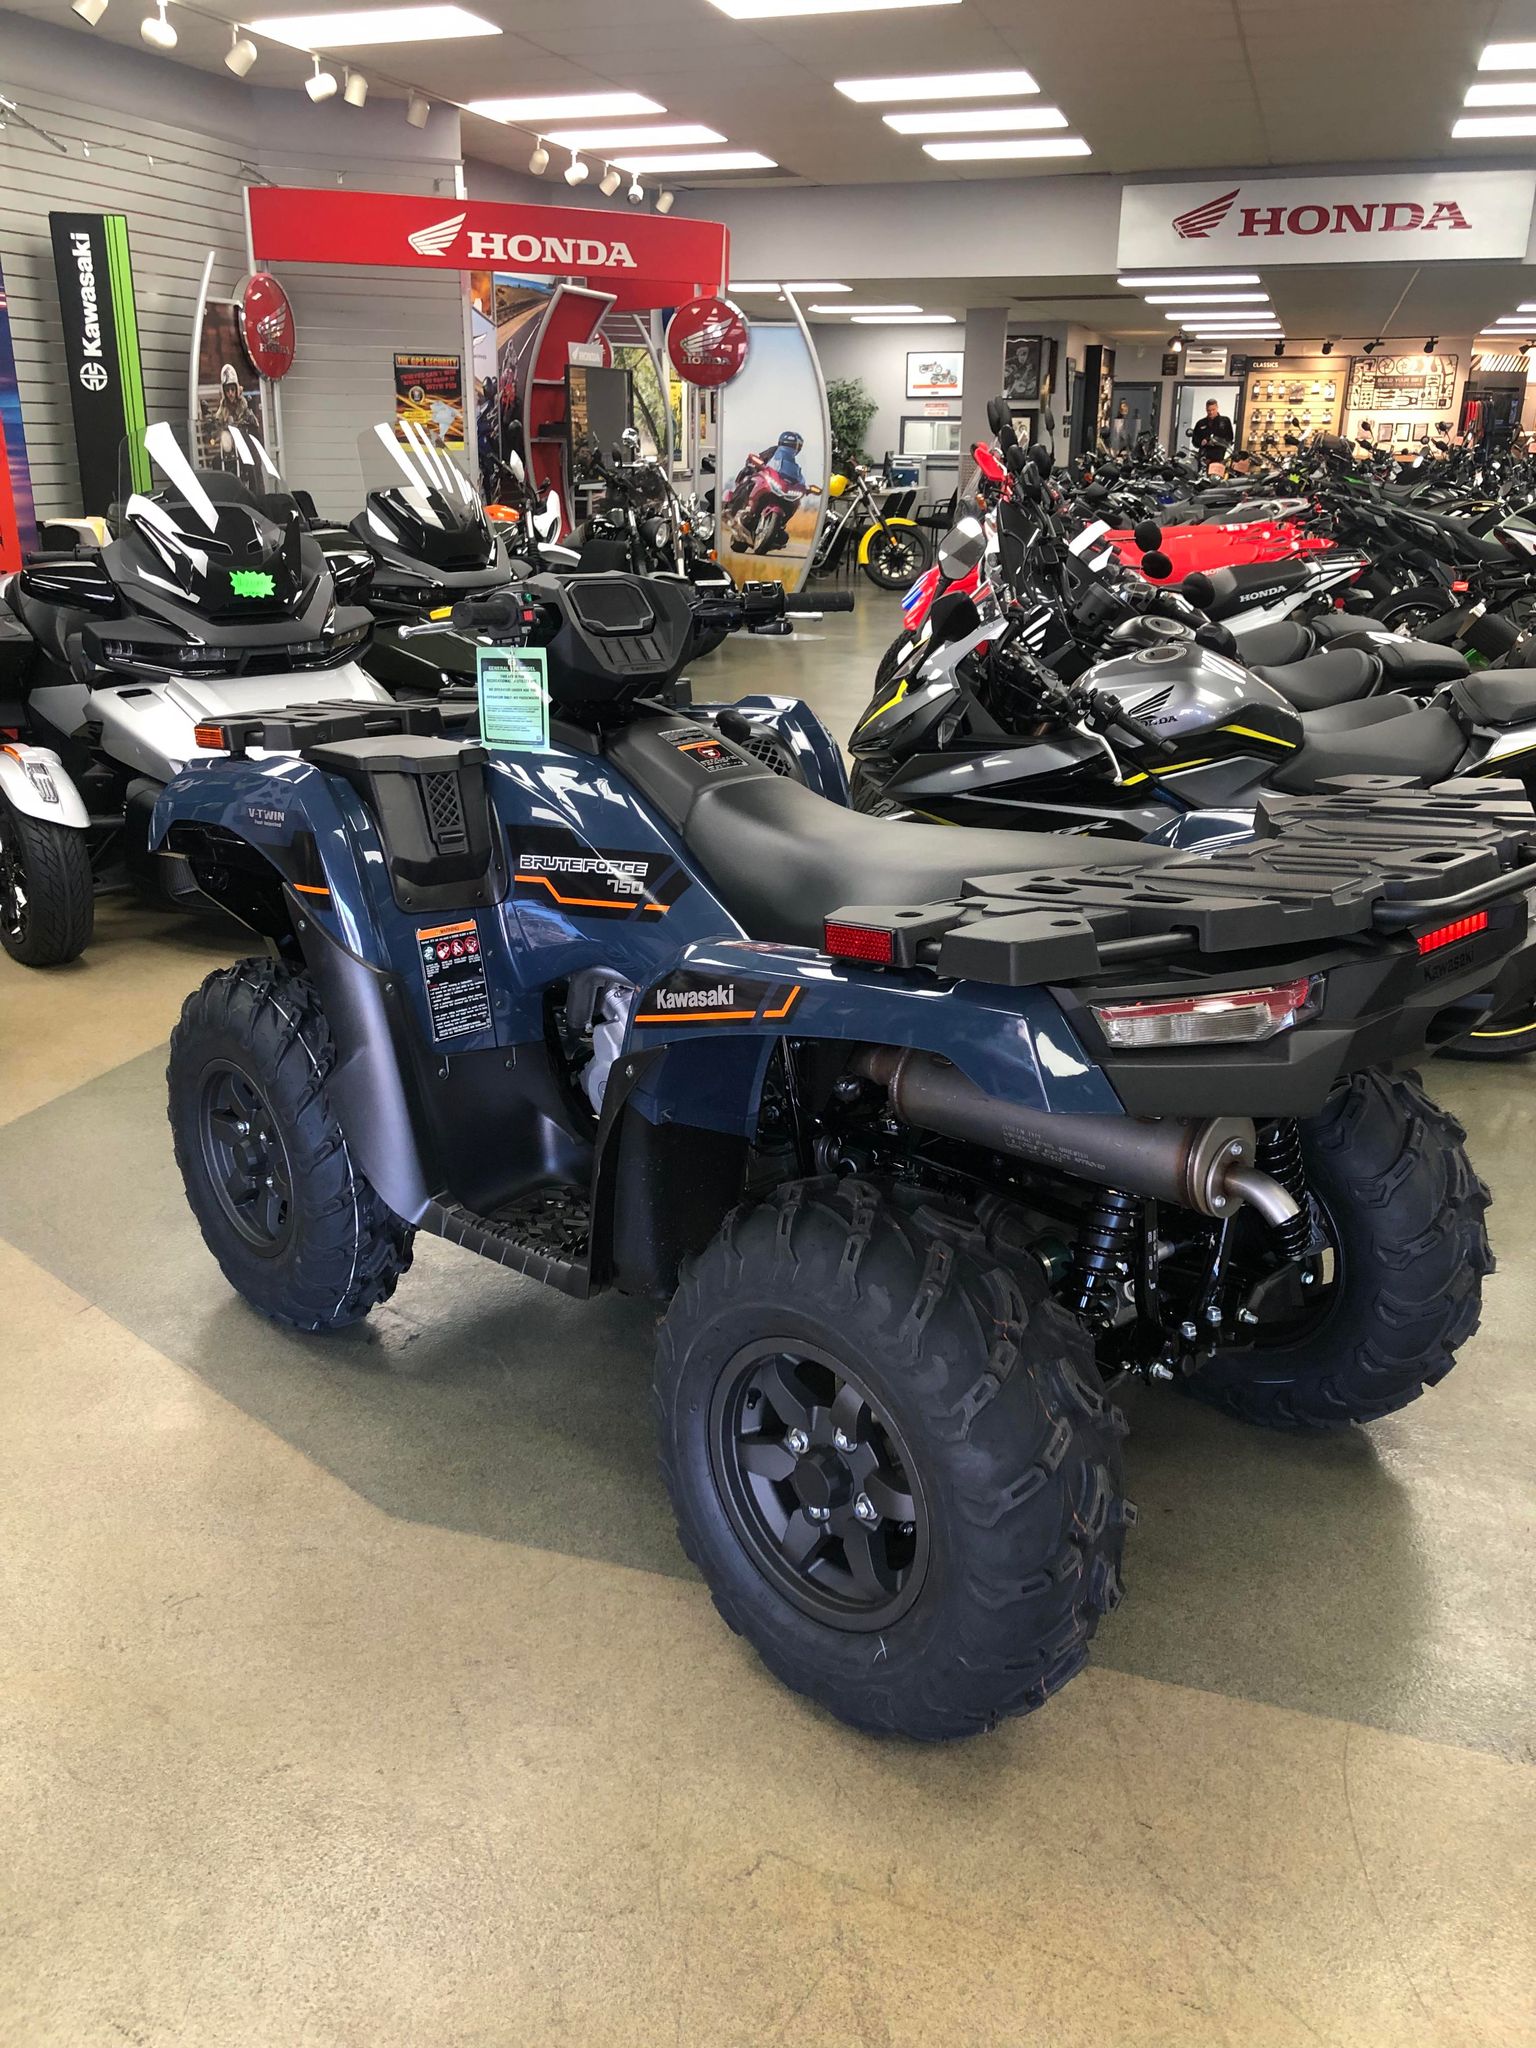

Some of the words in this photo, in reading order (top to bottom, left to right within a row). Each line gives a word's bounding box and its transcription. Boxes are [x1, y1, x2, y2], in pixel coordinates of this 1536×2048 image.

[1237, 201, 1473, 237] HONDA
[467, 231, 638, 268] HONDA
[70, 232, 103, 357] Kawasaki
[258, 342, 291, 355] HONDA
[681, 356, 731, 365] HONDA
[1239, 585, 1288, 603] HONDA
[248, 807, 285, 822] V-TWIN
[606, 878, 644, 895] 750
[1423, 943, 1475, 982] Kawasaki
[656, 983, 735, 1010] Kawasaki
